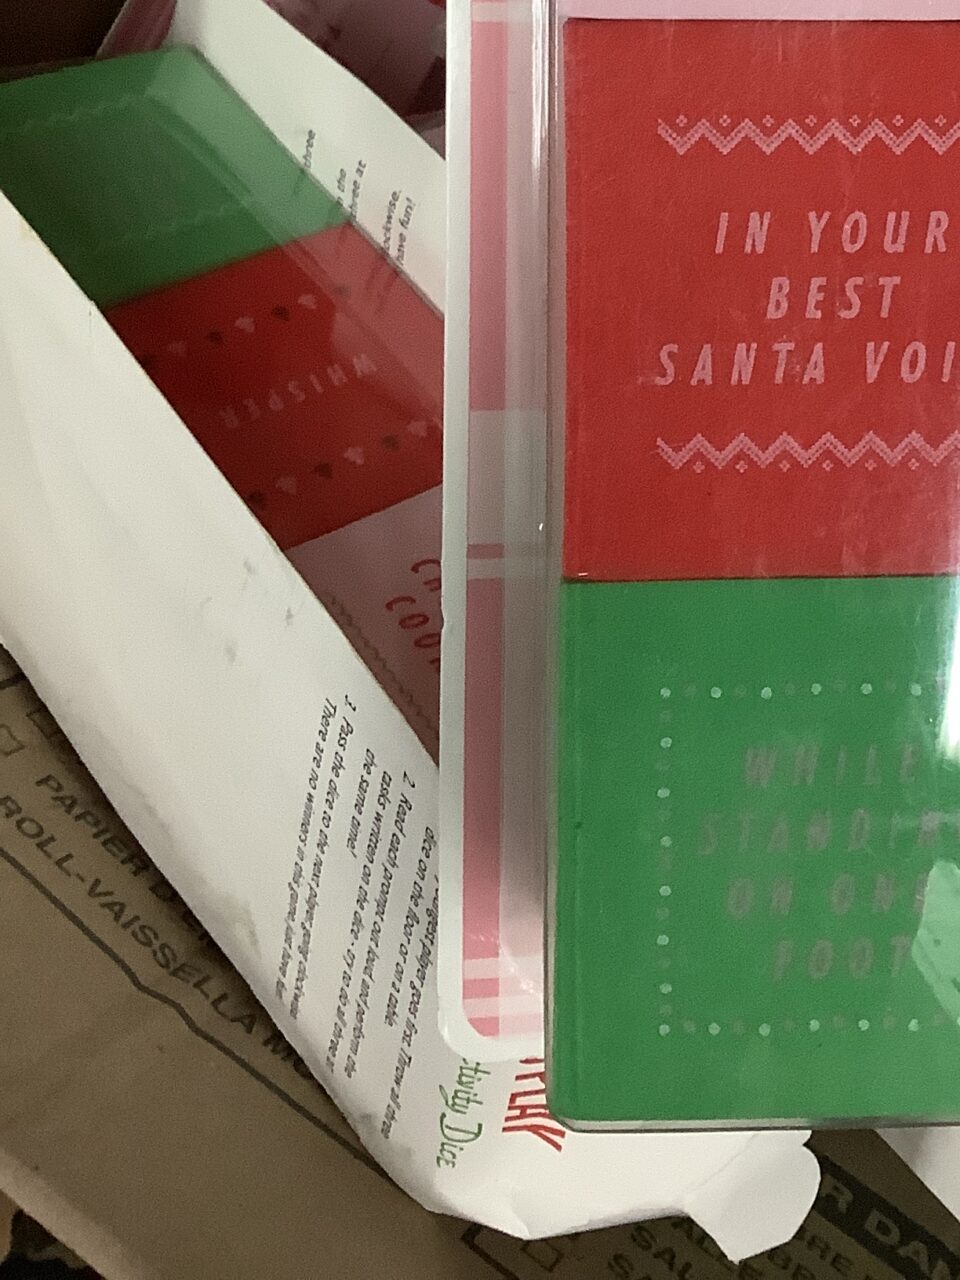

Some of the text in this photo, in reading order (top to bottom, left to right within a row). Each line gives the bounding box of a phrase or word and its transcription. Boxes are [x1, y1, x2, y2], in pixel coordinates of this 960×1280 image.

[714, 210, 950, 255] IN YOUR
[766, 276, 901, 320] BEST
[655, 342, 826, 386] SANTA
[318, 698, 337, 743] There
[312, 741, 324, 770] are
[744, 743, 923, 788] WHILE
[308, 767, 319, 791] no
[377, 771, 393, 810] tasks
[298, 791, 315, 847] winners
[311, 716, 354, 888] Pass the dice to the next
[346, 748, 378, 859] the same time!
[394, 793, 413, 838] Read
[35, 773, 150, 878] PAPIER
[365, 811, 384, 864] written
[421, 826, 438, 859] dice
[386, 832, 400, 869] each
[360, 864, 372, 886] on
[416, 859, 427, 881] on
[356, 885, 370, 911] the
[374, 862, 393, 922] prompt
[409, 881, 424, 908] the
[727, 873, 794, 920] ON
[350, 910, 364, 941] dice
[370, 921, 382, 949] out
[403, 906, 420, 945] floor
[342, 948, 356, 973] try
[393, 961, 404, 983] on
[398, 943, 408, 964] or
[416, 938, 434, 988] player
[339, 986, 350, 1007] do
[342, 969, 351, 988] to
[359, 978, 371, 1010] and
[392, 981, 400, 994] a
[408, 980, 422, 1019] goes
[349, 1000, 366, 1056] perform
[344, 1054, 357, 1079] the
[394, 1047, 413, 1091] Throw
[390, 1087, 401, 1111] all
[380, 1104, 398, 1140] three
[436, 1112, 483, 1169] Dice
